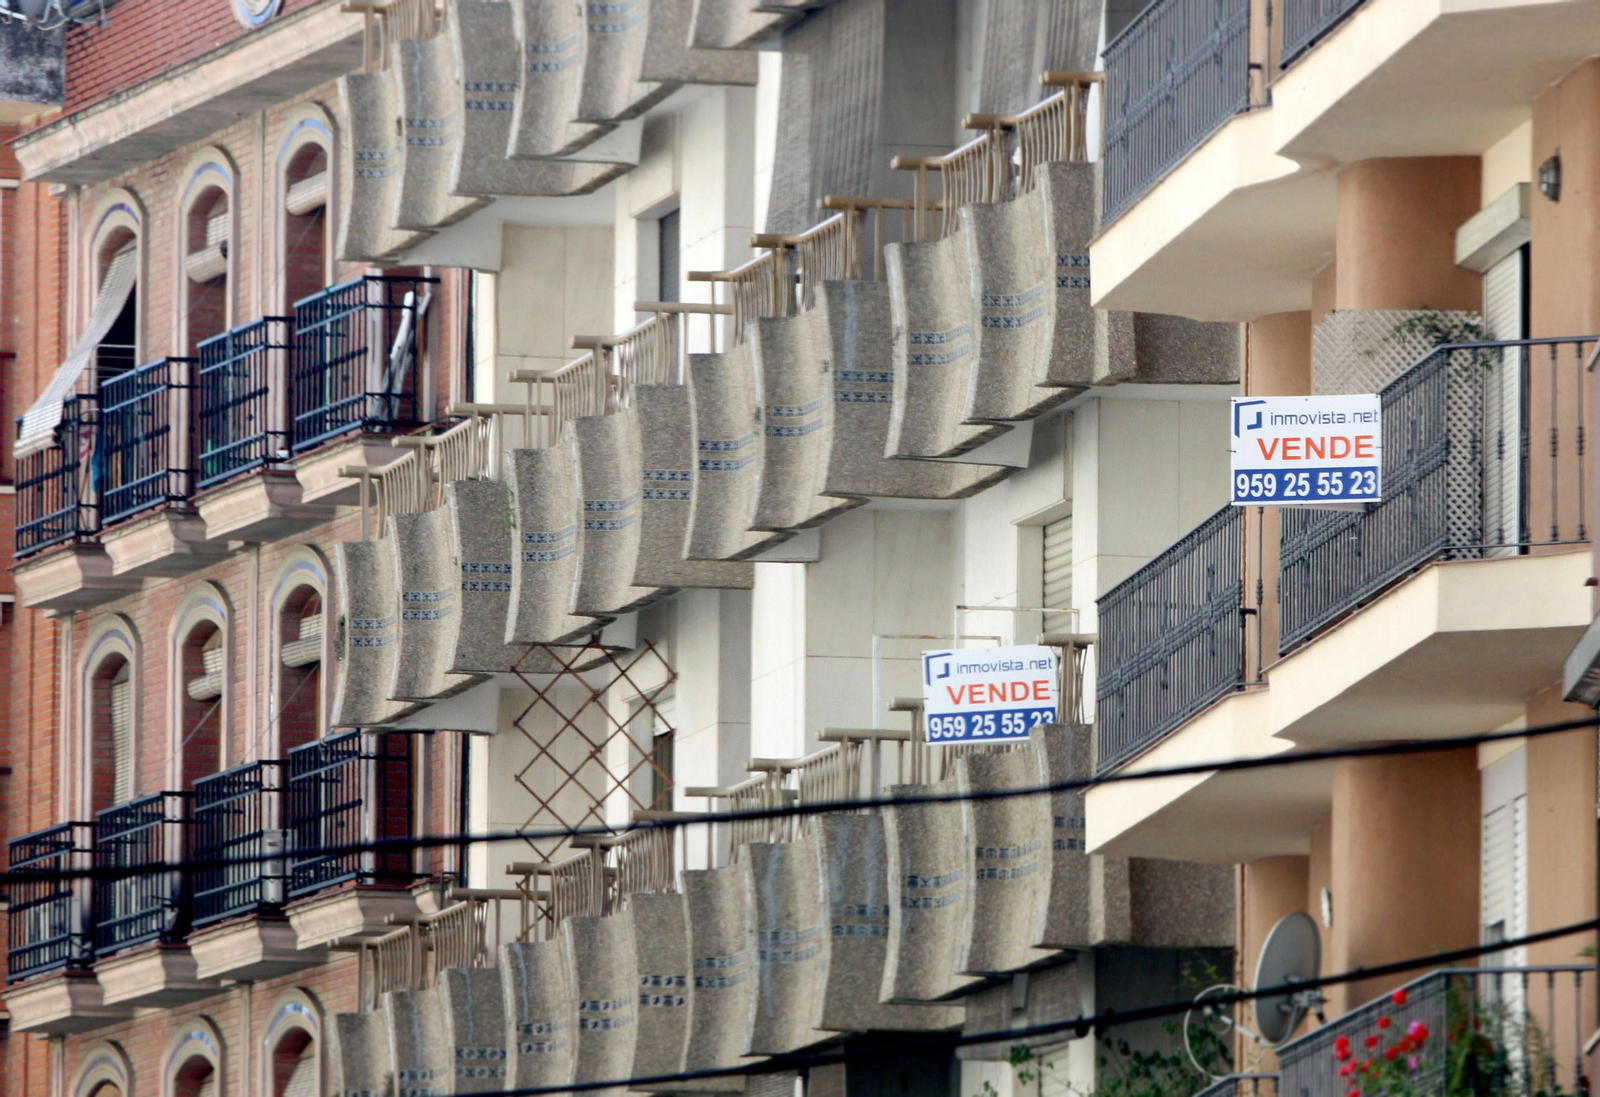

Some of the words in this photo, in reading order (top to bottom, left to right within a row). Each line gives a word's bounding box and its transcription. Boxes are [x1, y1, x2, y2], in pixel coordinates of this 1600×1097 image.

[1270, 409, 1379, 425] inmovista.net
[1257, 435, 1374, 460] VENDE
[1236, 472, 1277, 498] 959
[1283, 472, 1311, 497] 25
[1317, 472, 1344, 496] 55
[1349, 470, 1376, 495] 23
[956, 658, 1053, 674] inmovista.net
[946, 680, 1051, 705] VENDE
[930, 716, 966, 738] 959
[971, 714, 996, 736] 25
[1001, 712, 1026, 734] 55
